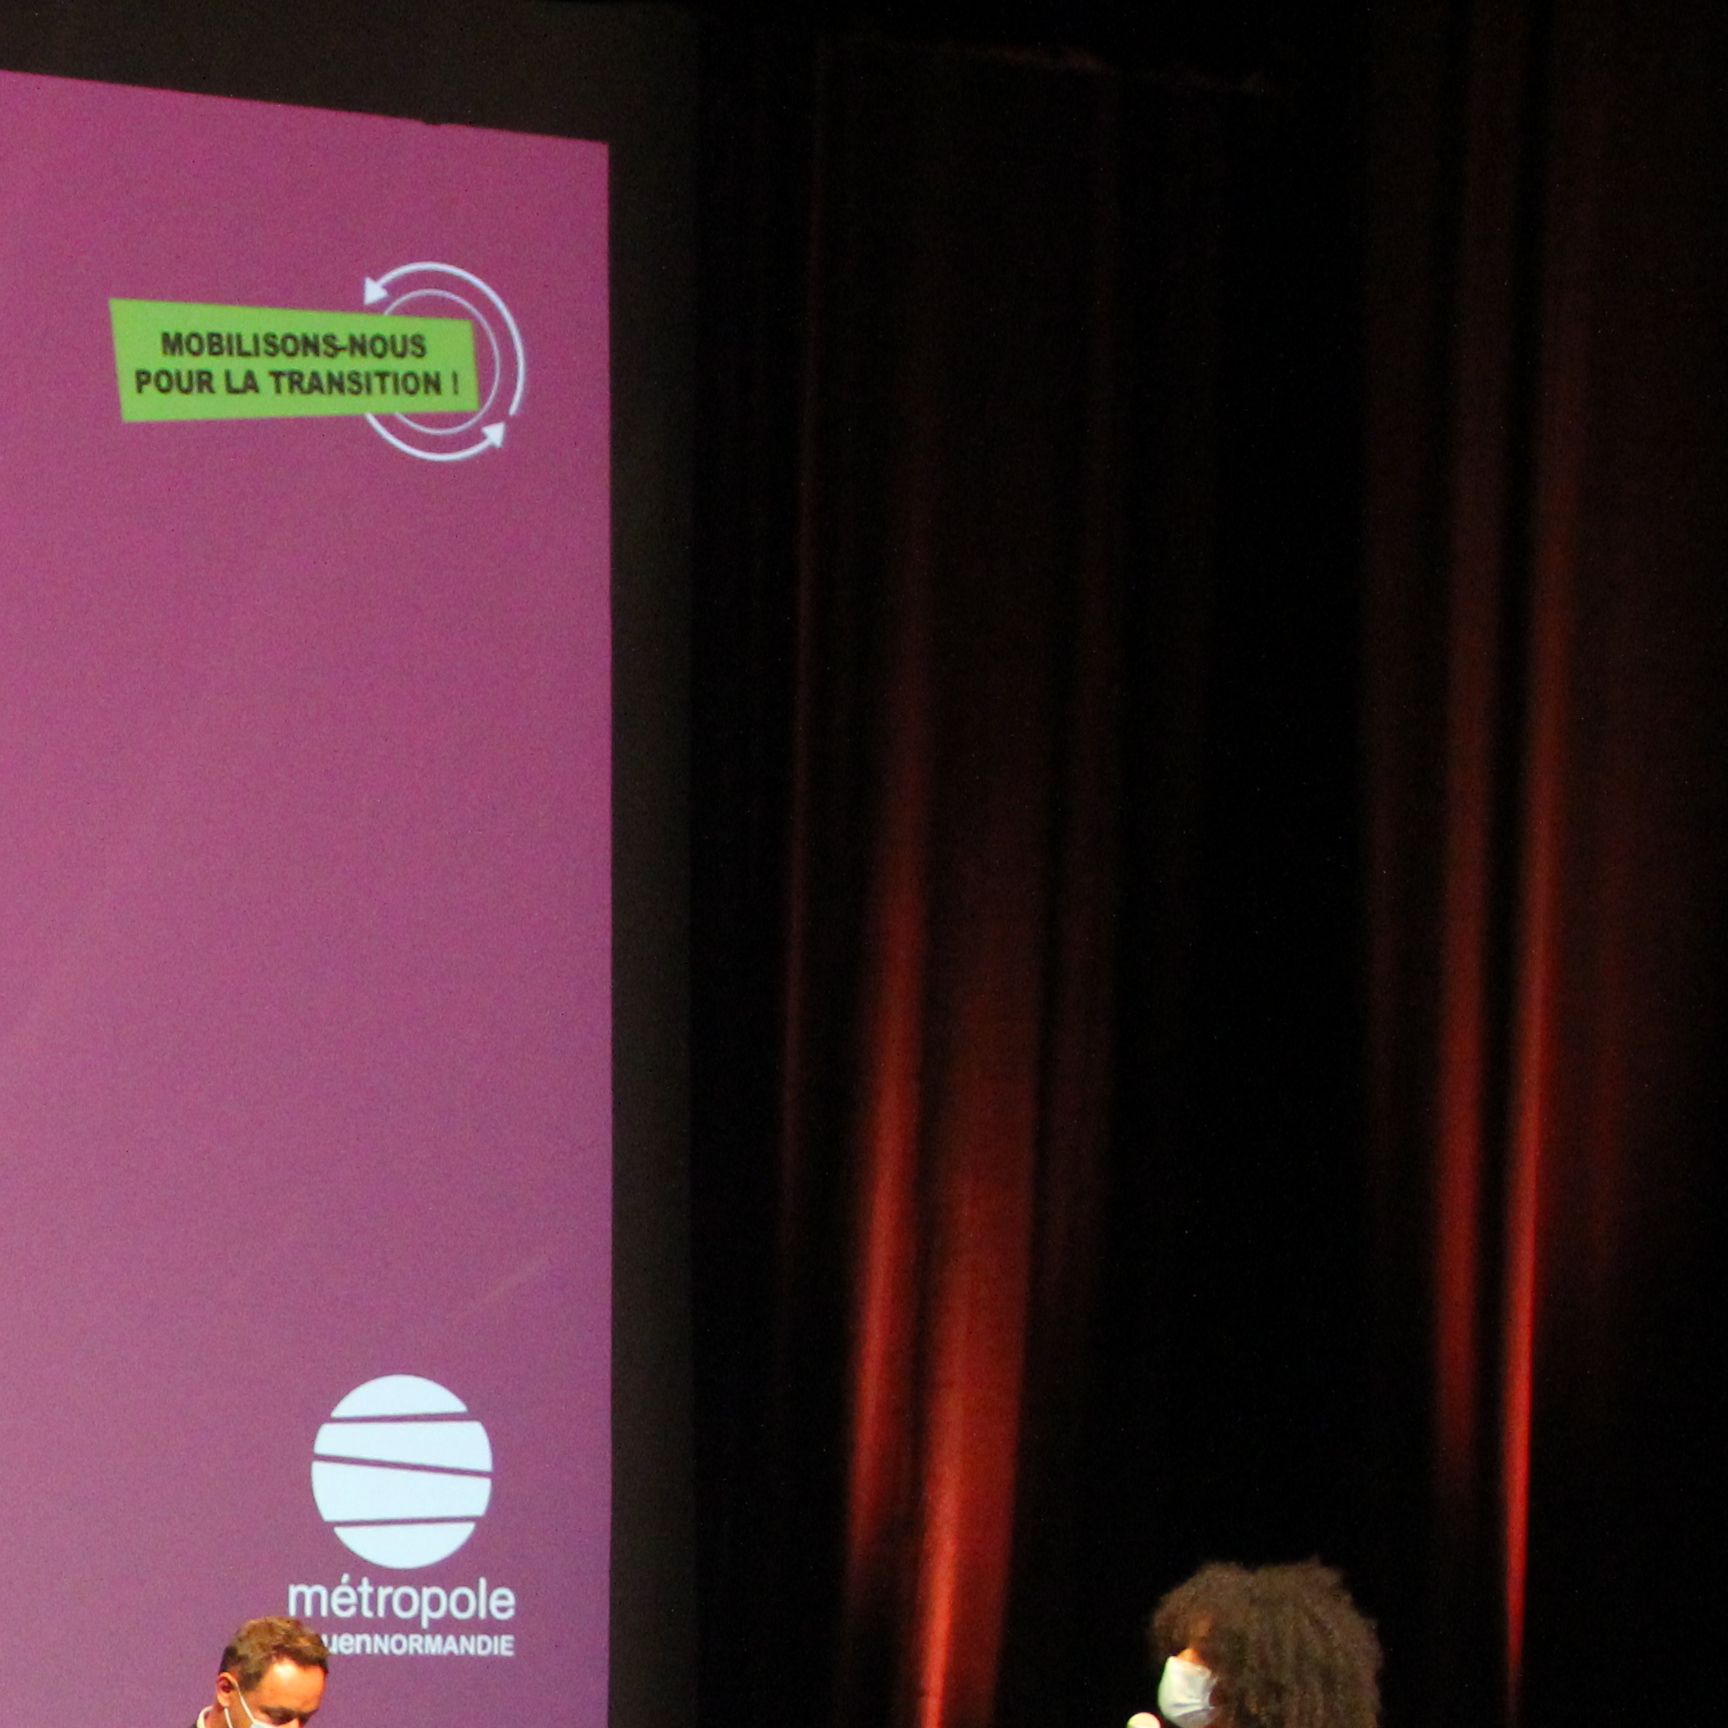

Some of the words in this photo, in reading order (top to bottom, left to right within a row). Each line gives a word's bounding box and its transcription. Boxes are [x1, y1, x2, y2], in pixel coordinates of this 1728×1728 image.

[161, 331, 427, 358] MOBILISONS-NOUS
[135, 369, 216, 395] POUR
[224, 370, 260, 395] LA
[268, 370, 442, 397] TRANSITION
[288, 1573, 515, 1629] métropole
[320, 1632, 515, 1657] uenNORMANDIE
